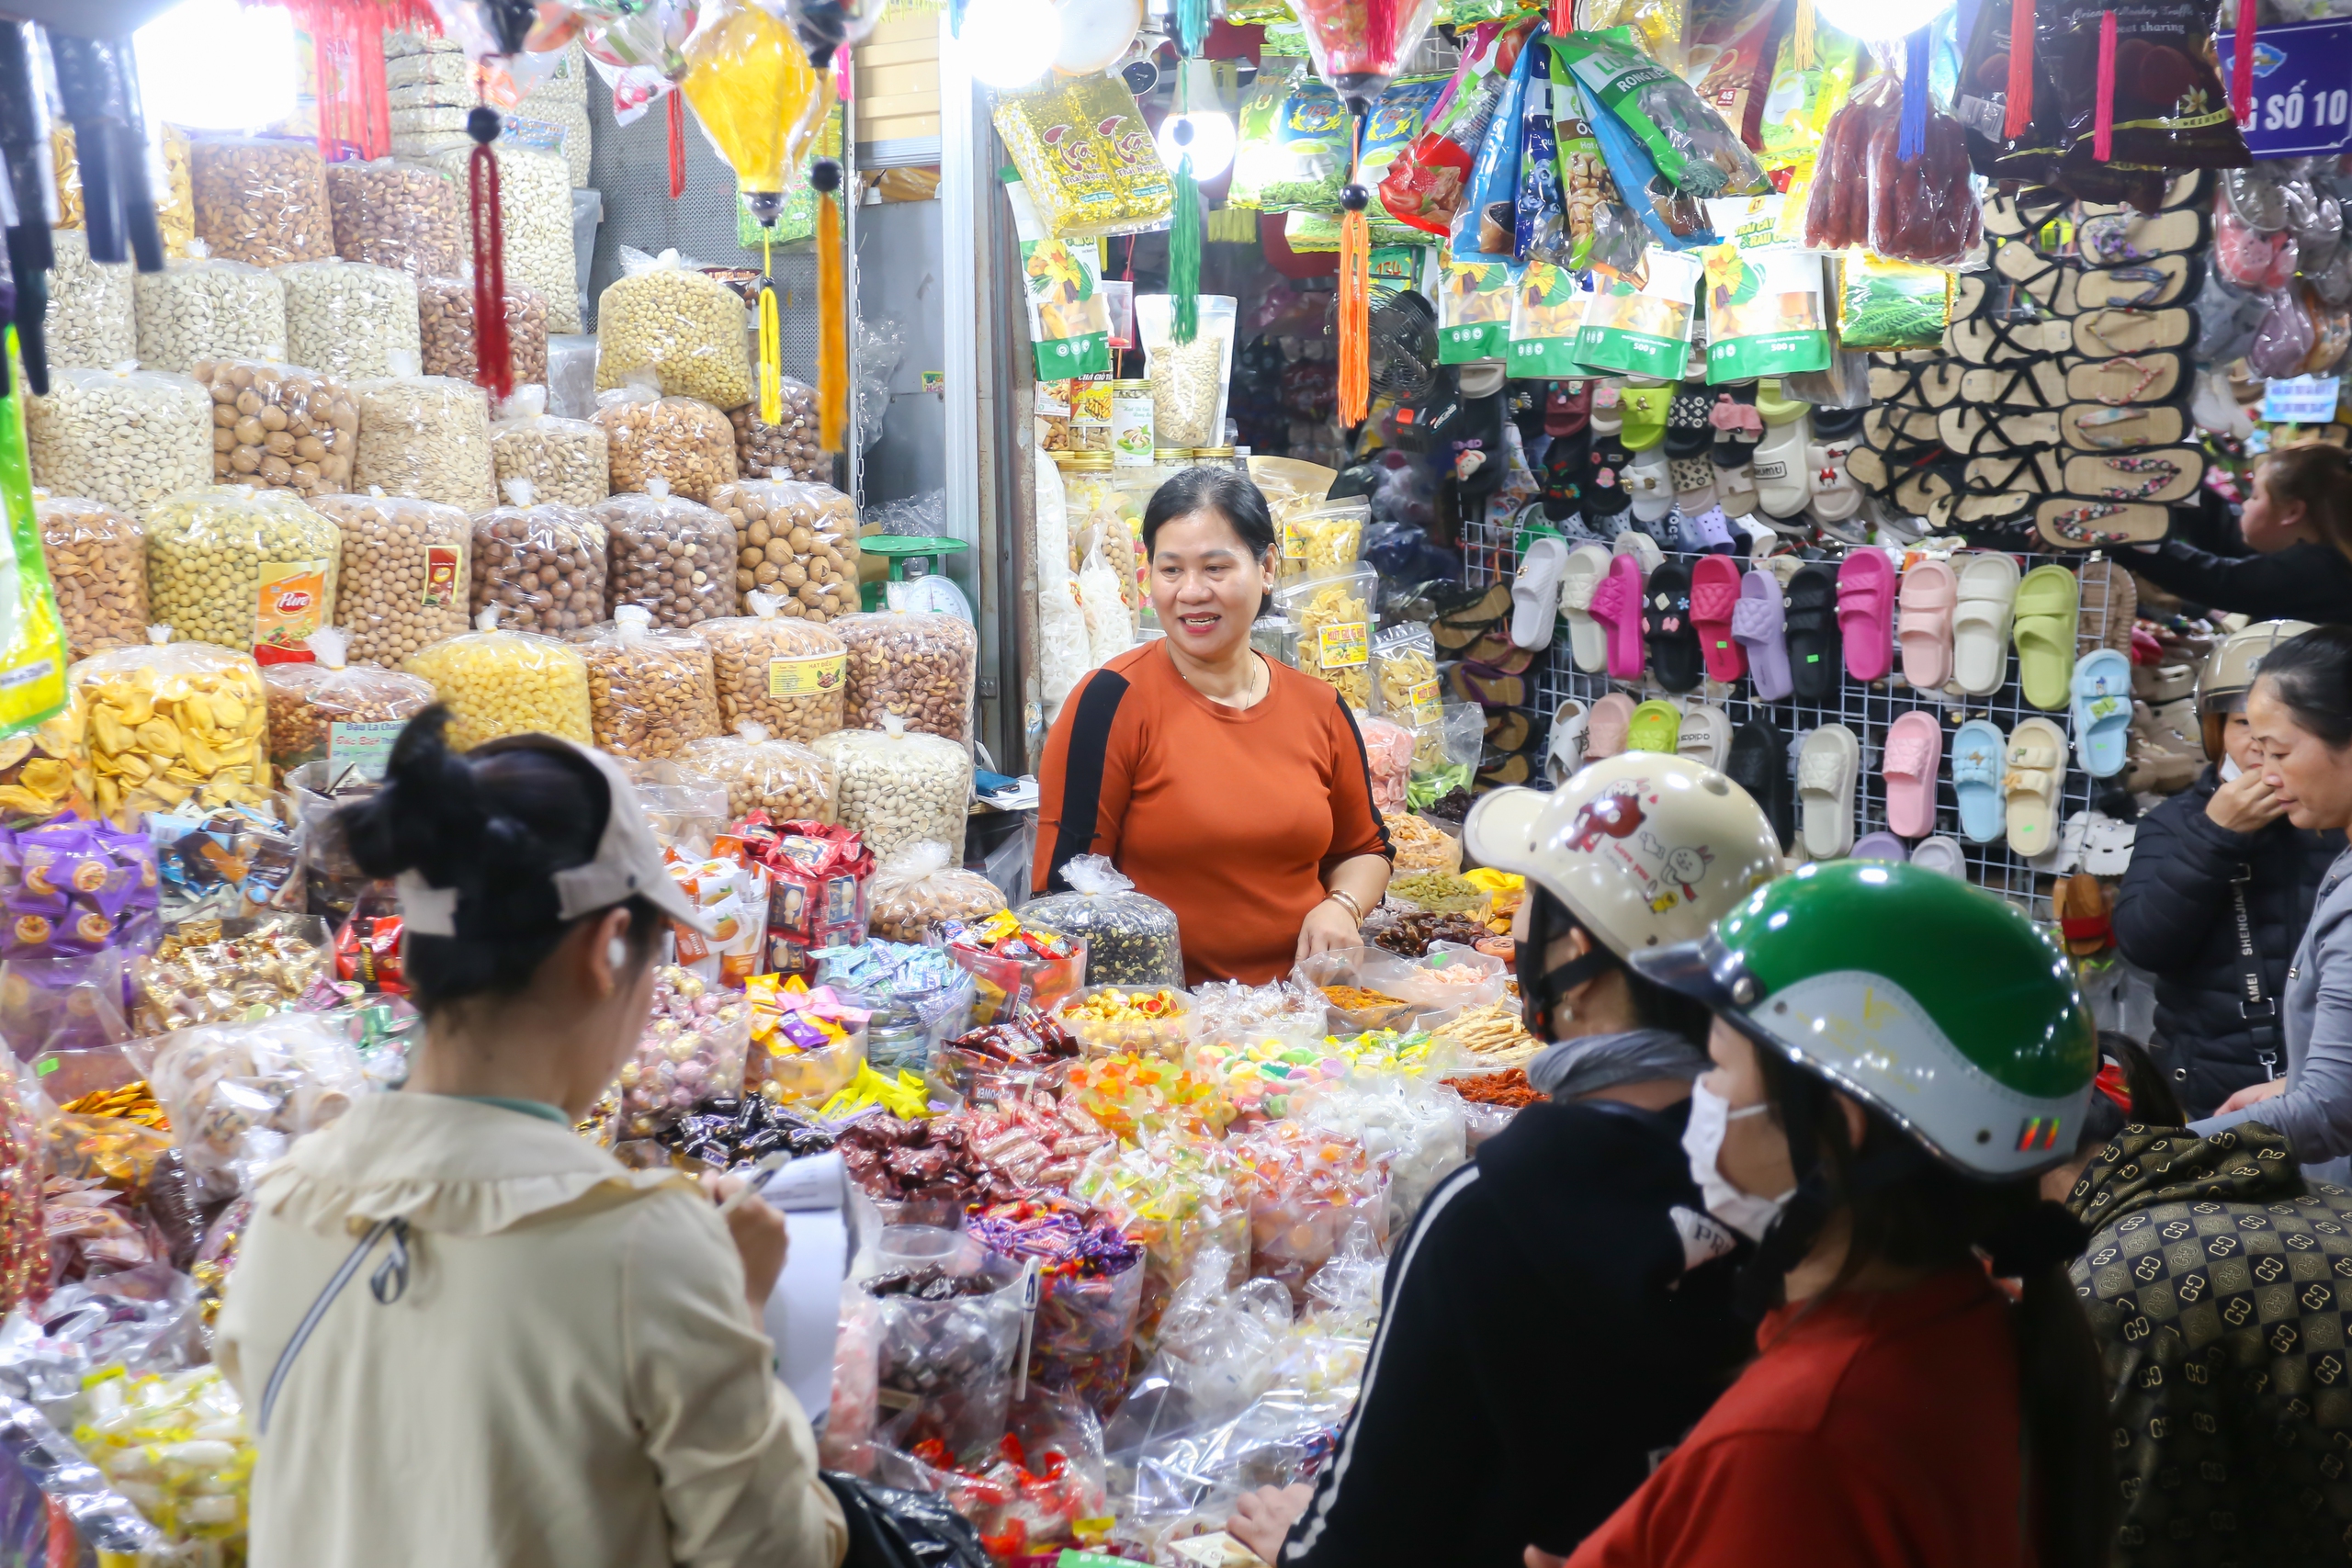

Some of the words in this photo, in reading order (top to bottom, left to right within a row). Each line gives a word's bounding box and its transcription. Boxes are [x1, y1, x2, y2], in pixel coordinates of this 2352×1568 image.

[2140, 21, 2186, 35] sharing
[1616, 72, 1651, 92] RONG
[1721, 90, 1734, 101] 45
[2265, 79, 2308, 130] SỐ
[2312, 89, 2348, 127] 10
[1750, 232, 1772, 249] RAU
[1374, 261, 1402, 276] 134
[1633, 342, 1649, 353] 500
[1770, 343, 1787, 352] 500
